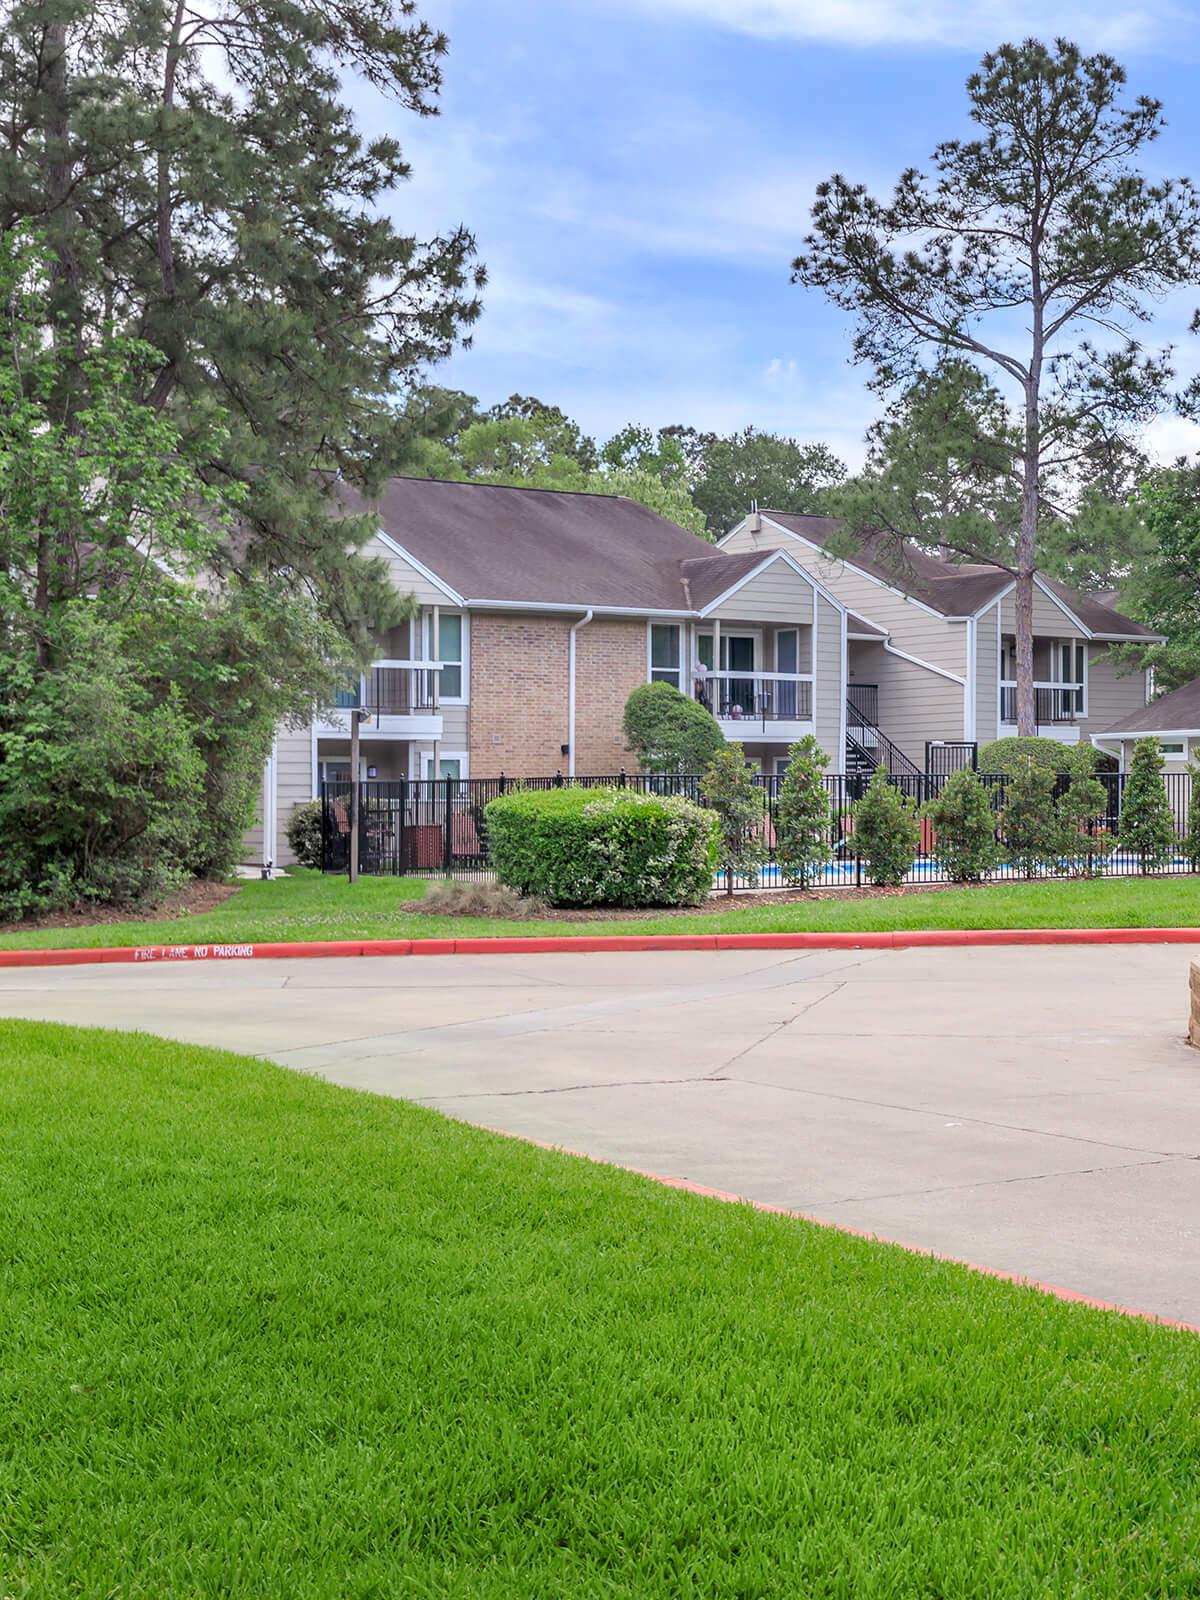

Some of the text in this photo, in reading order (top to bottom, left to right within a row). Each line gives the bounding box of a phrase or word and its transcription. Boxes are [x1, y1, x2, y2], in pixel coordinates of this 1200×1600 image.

[134, 945, 253, 960] FIRE LANE NO PARKING
